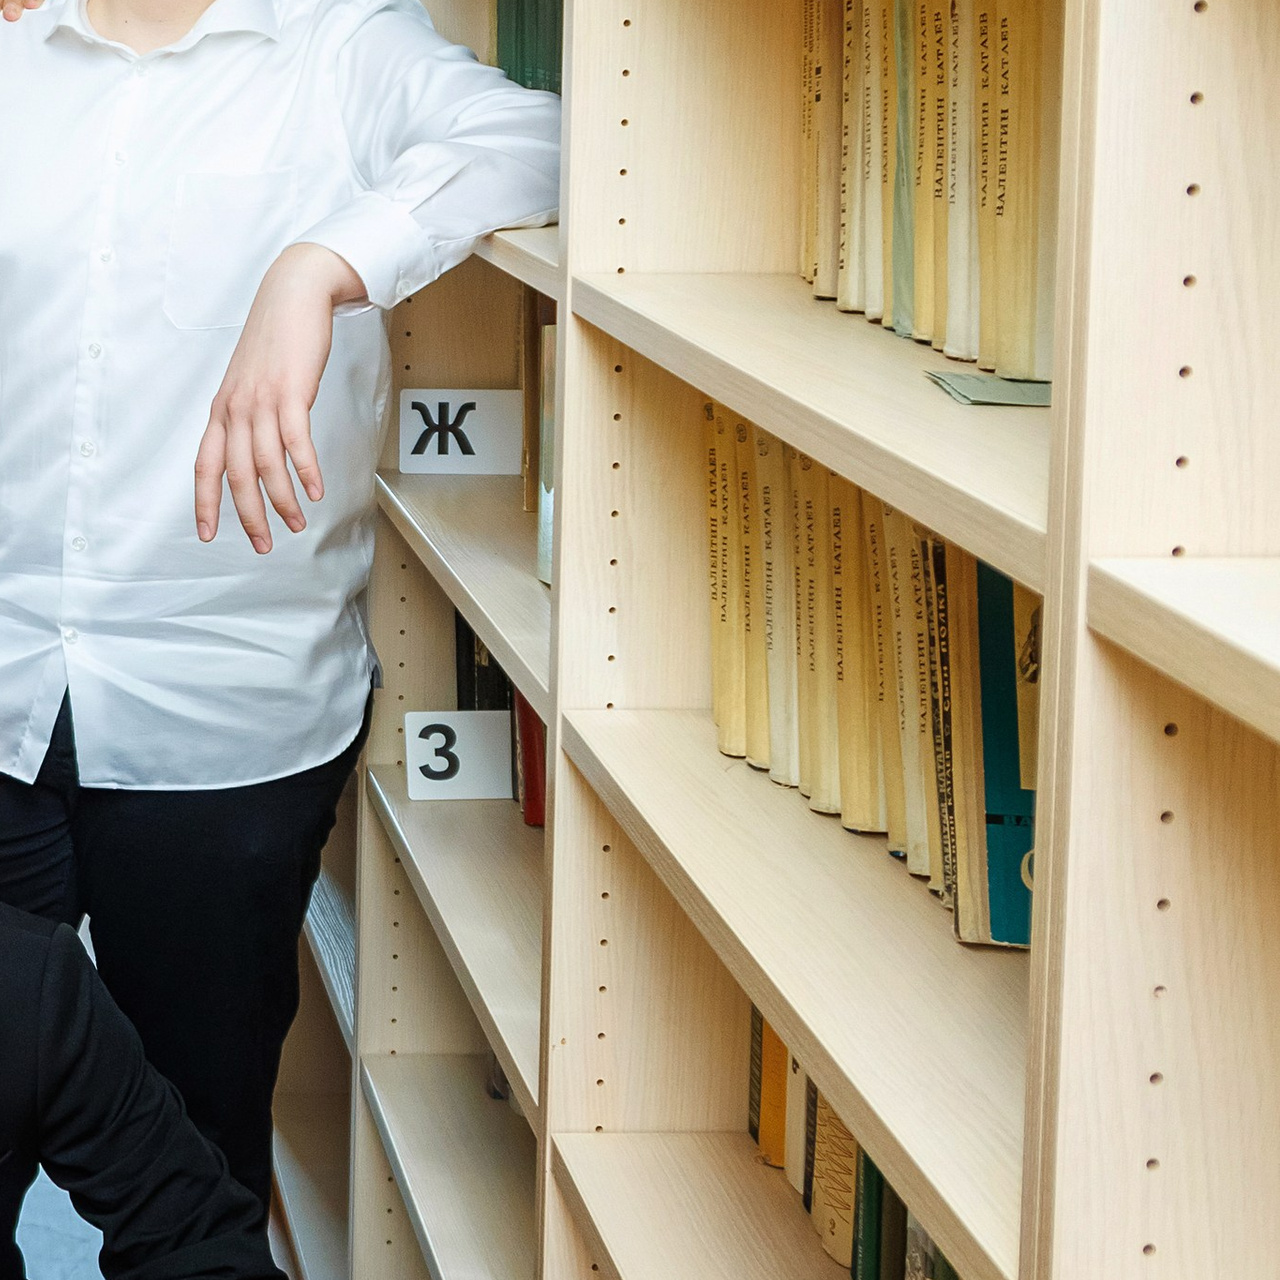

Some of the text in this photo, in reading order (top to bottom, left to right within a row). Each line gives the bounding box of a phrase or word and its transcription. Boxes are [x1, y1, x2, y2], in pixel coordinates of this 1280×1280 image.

[916, 3, 927, 187] ВАЛЕНТИН КАТАЕВ
[934, 11, 945, 199] ВАЛЕНТИН КАТАЕВ
[980, 12, 989, 208] ВАЛЕНТИН КАТАЕВ
[996, 17, 1009, 218] ВАЛЕНТИН КАТАЕВ
[411, 400, 477, 456] Ж
[708, 447, 718, 601] ВАЛЕНТИН КАТАЕВ
[720, 536, 728, 623] ВАЛЕНТИН
[806, 500, 816, 672] ВАЛЕНТИН КАТАЕВ
[833, 506, 844, 682] ВАЛЕНТИН КАТАЕВ
[937, 583, 948, 653] ПОЛКА
[943, 665, 951, 712] СЫН
[417, 723, 461, 781] З
[945, 750, 953, 806] КАТАЕВ
